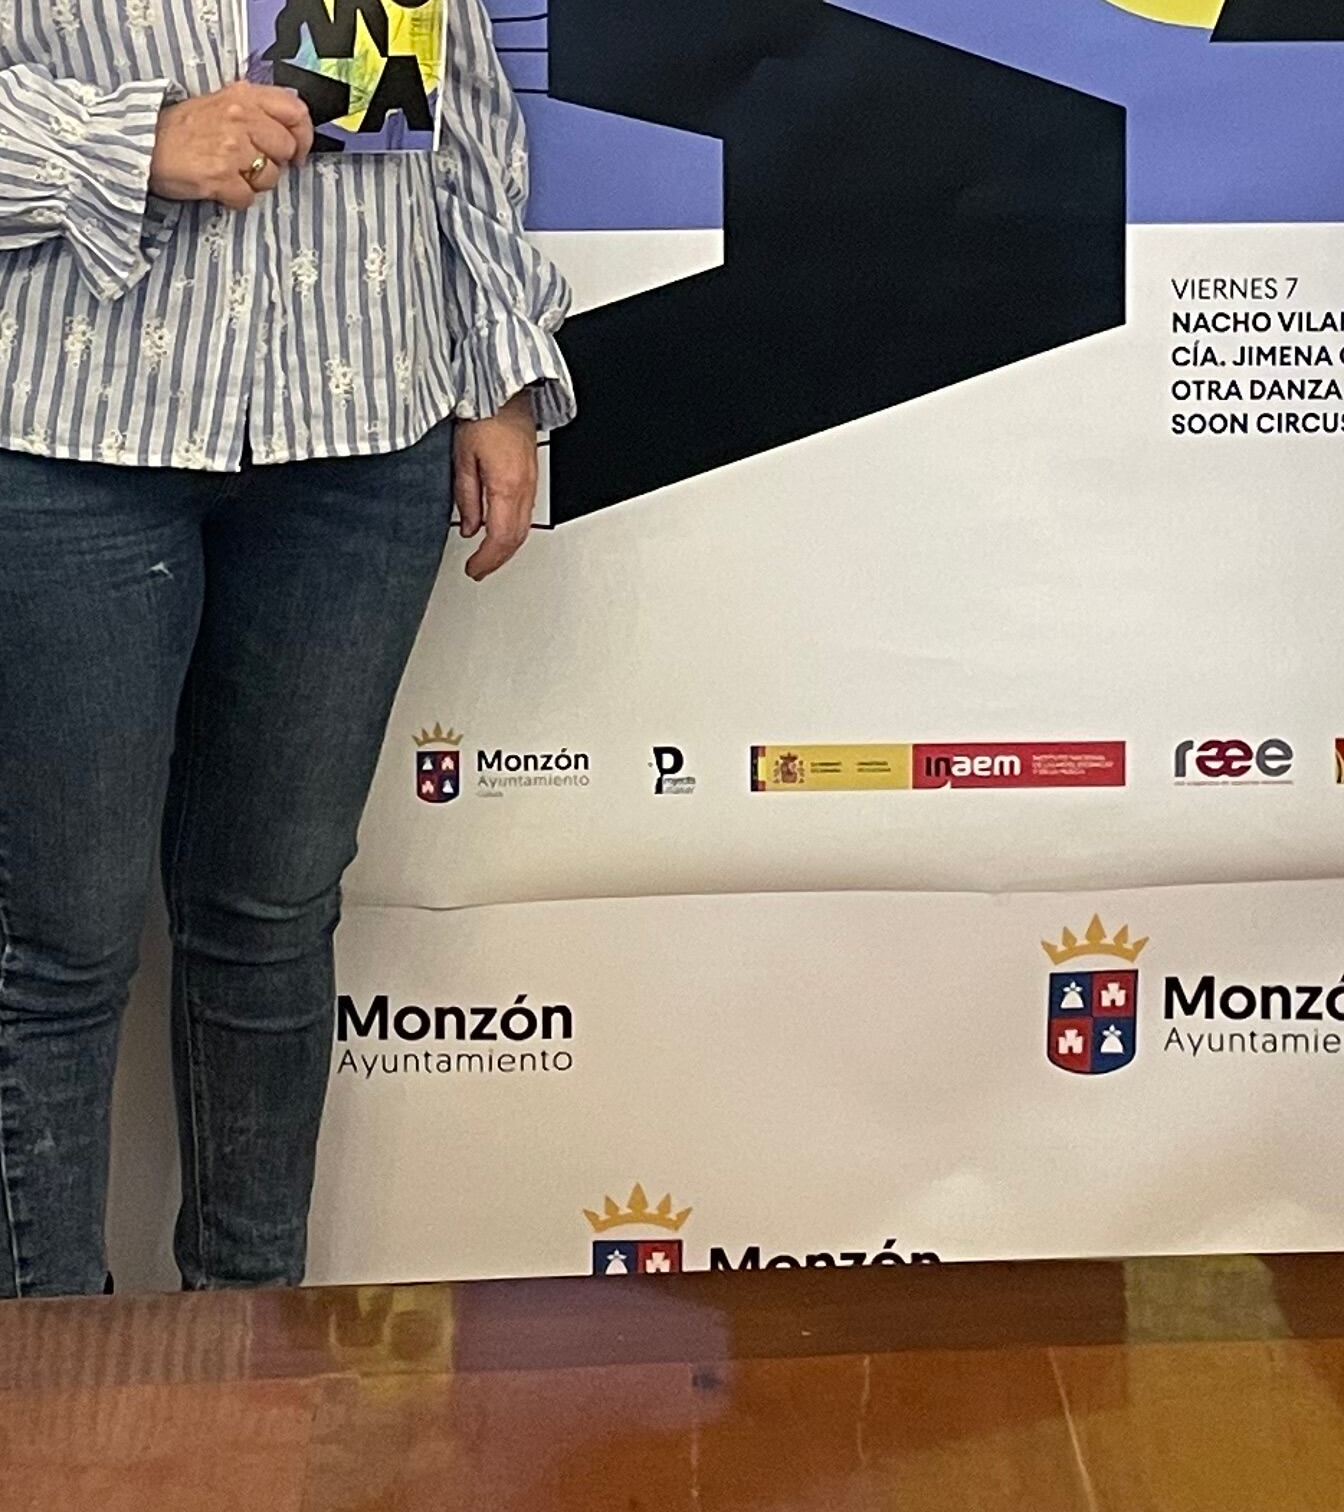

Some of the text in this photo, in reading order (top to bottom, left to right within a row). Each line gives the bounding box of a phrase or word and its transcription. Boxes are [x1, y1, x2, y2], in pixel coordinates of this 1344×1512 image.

[1171, 277, 1298, 301] VIERNES 7
[1171, 311, 1272, 334] NACHO
[1171, 340, 1226, 367] CÍA.
[1232, 344, 1332, 366] JIMENA
[1171, 378, 1343, 402] OTRA DANZA
[1171, 412, 1248, 436] SOON
[477, 748, 589, 772] Monzón
[925, 753, 1021, 777] inaem
[478, 774, 590, 788] Ayuntamiento
[337, 993, 573, 1042] Monzón
[337, 1048, 573, 1079] Ayuntamiento
